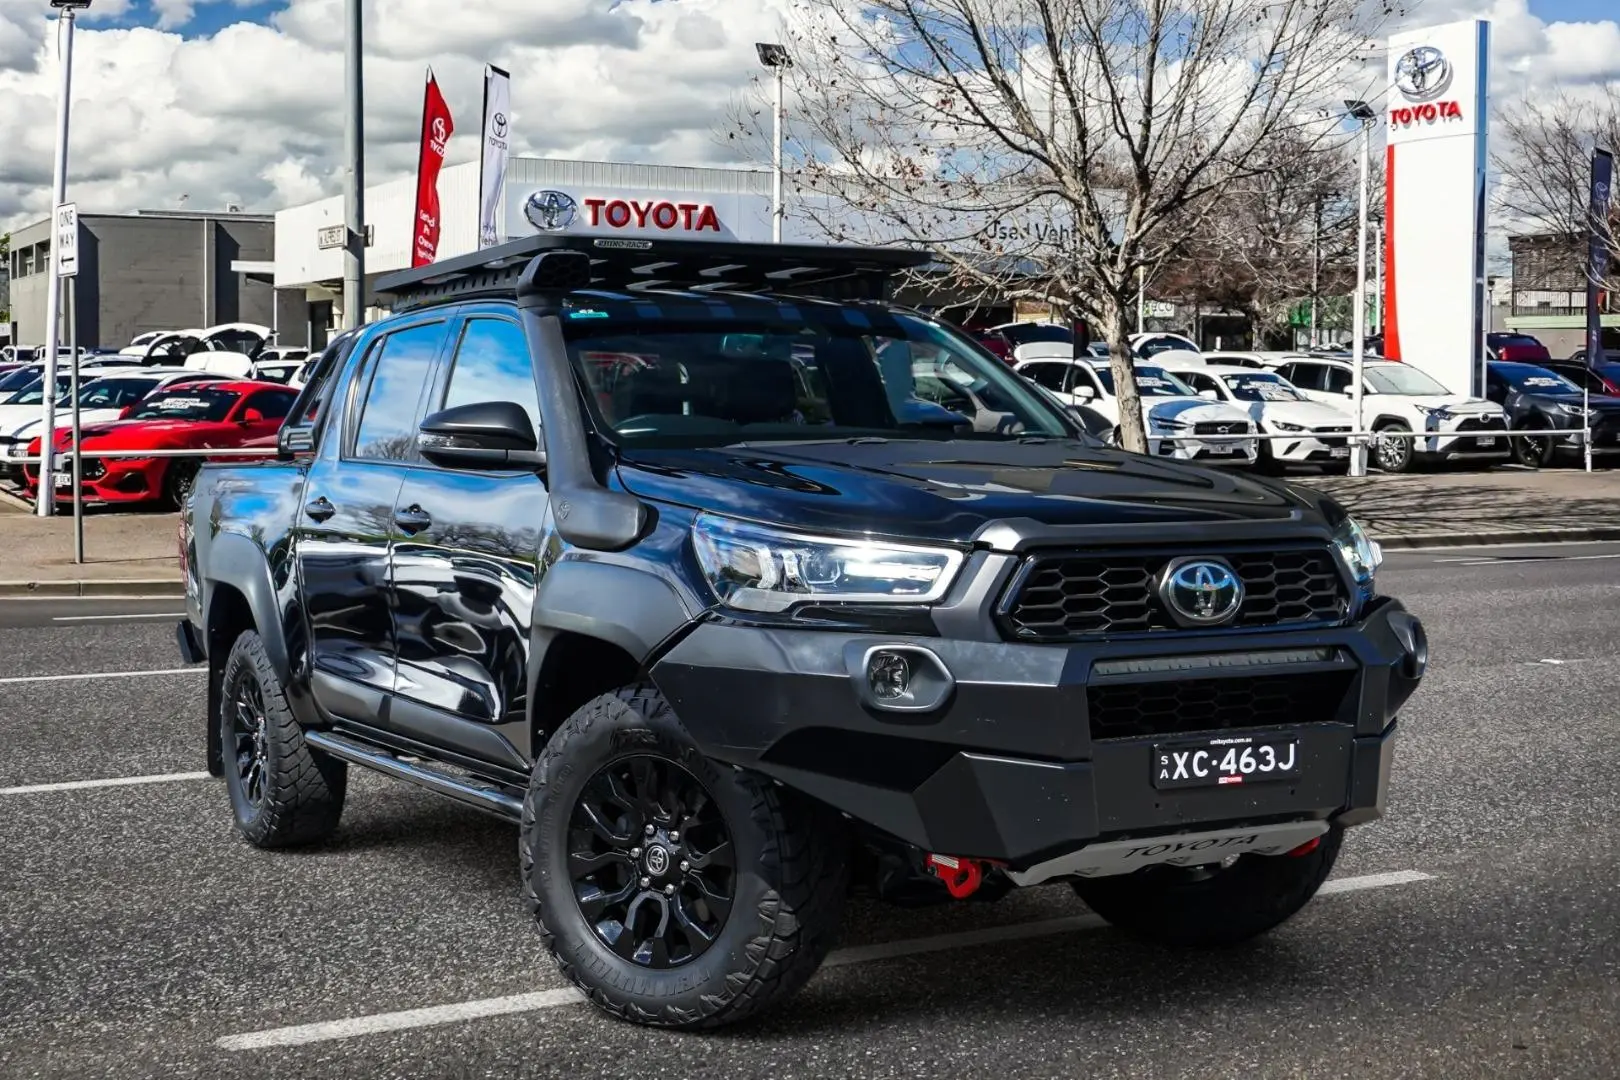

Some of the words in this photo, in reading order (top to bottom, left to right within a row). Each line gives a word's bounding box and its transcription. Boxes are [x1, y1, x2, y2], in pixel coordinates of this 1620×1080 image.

[1389, 101, 1463, 125] TOYOTA
[60, 209, 74, 228] ONE
[584, 198, 720, 232] TOYOTA
[60, 232, 75, 248] WAY
[1122, 834, 1259, 859] TOYOTA
